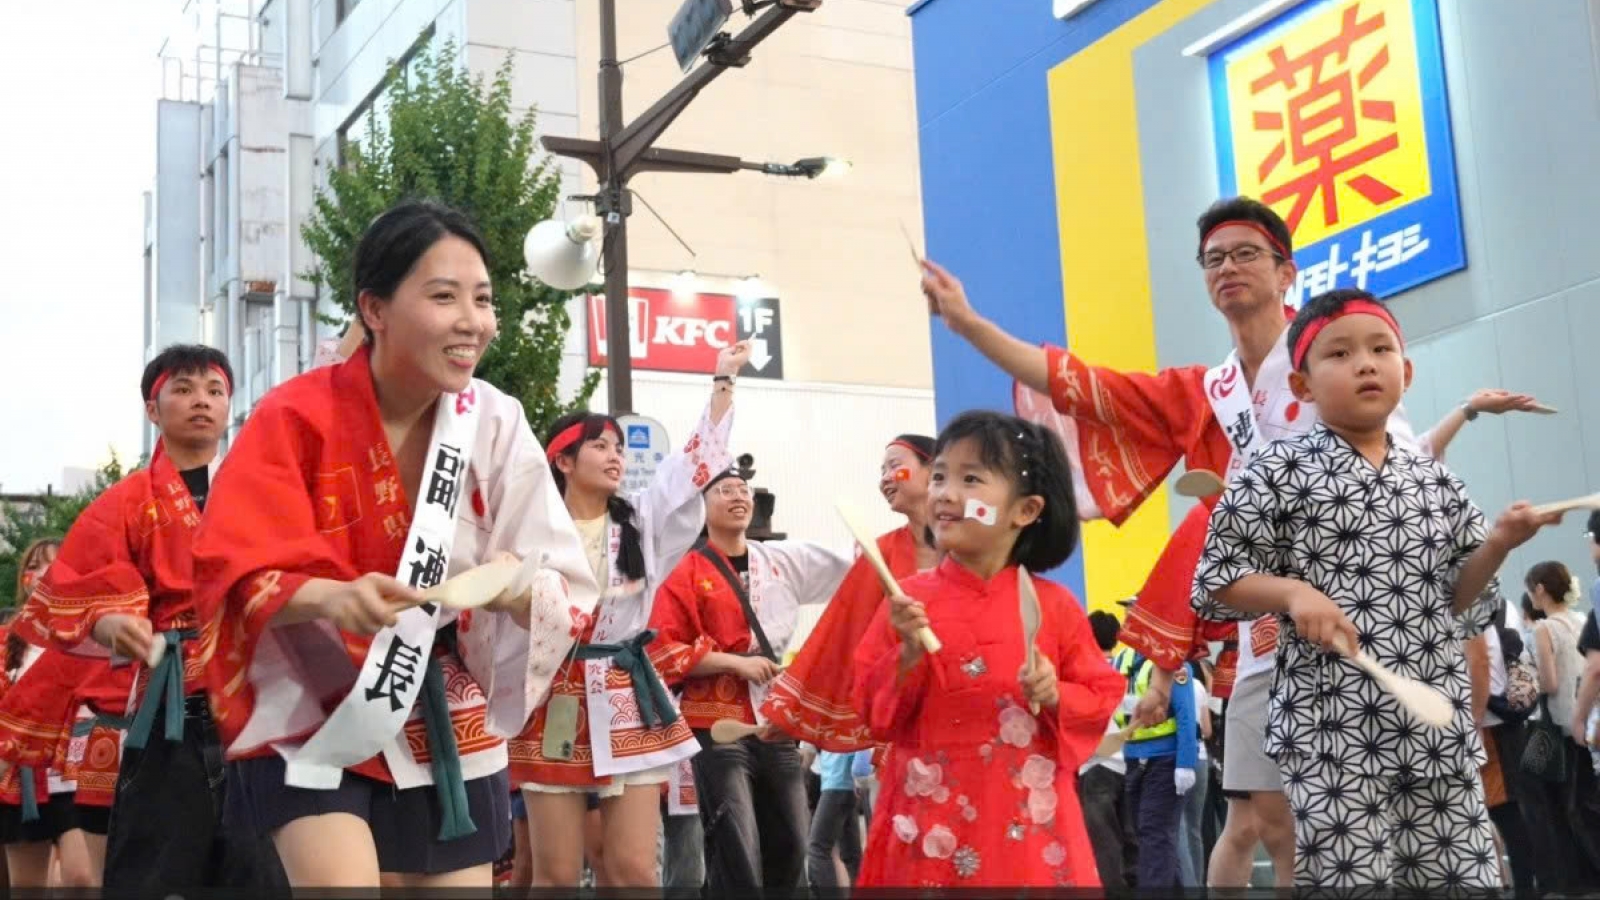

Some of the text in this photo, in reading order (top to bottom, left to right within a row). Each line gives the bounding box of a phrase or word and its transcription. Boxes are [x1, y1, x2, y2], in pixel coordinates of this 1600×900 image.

[1250, 2, 1404, 237] 薬
[652, 315, 730, 349] KFC
[739, 305, 774, 334] 1F
